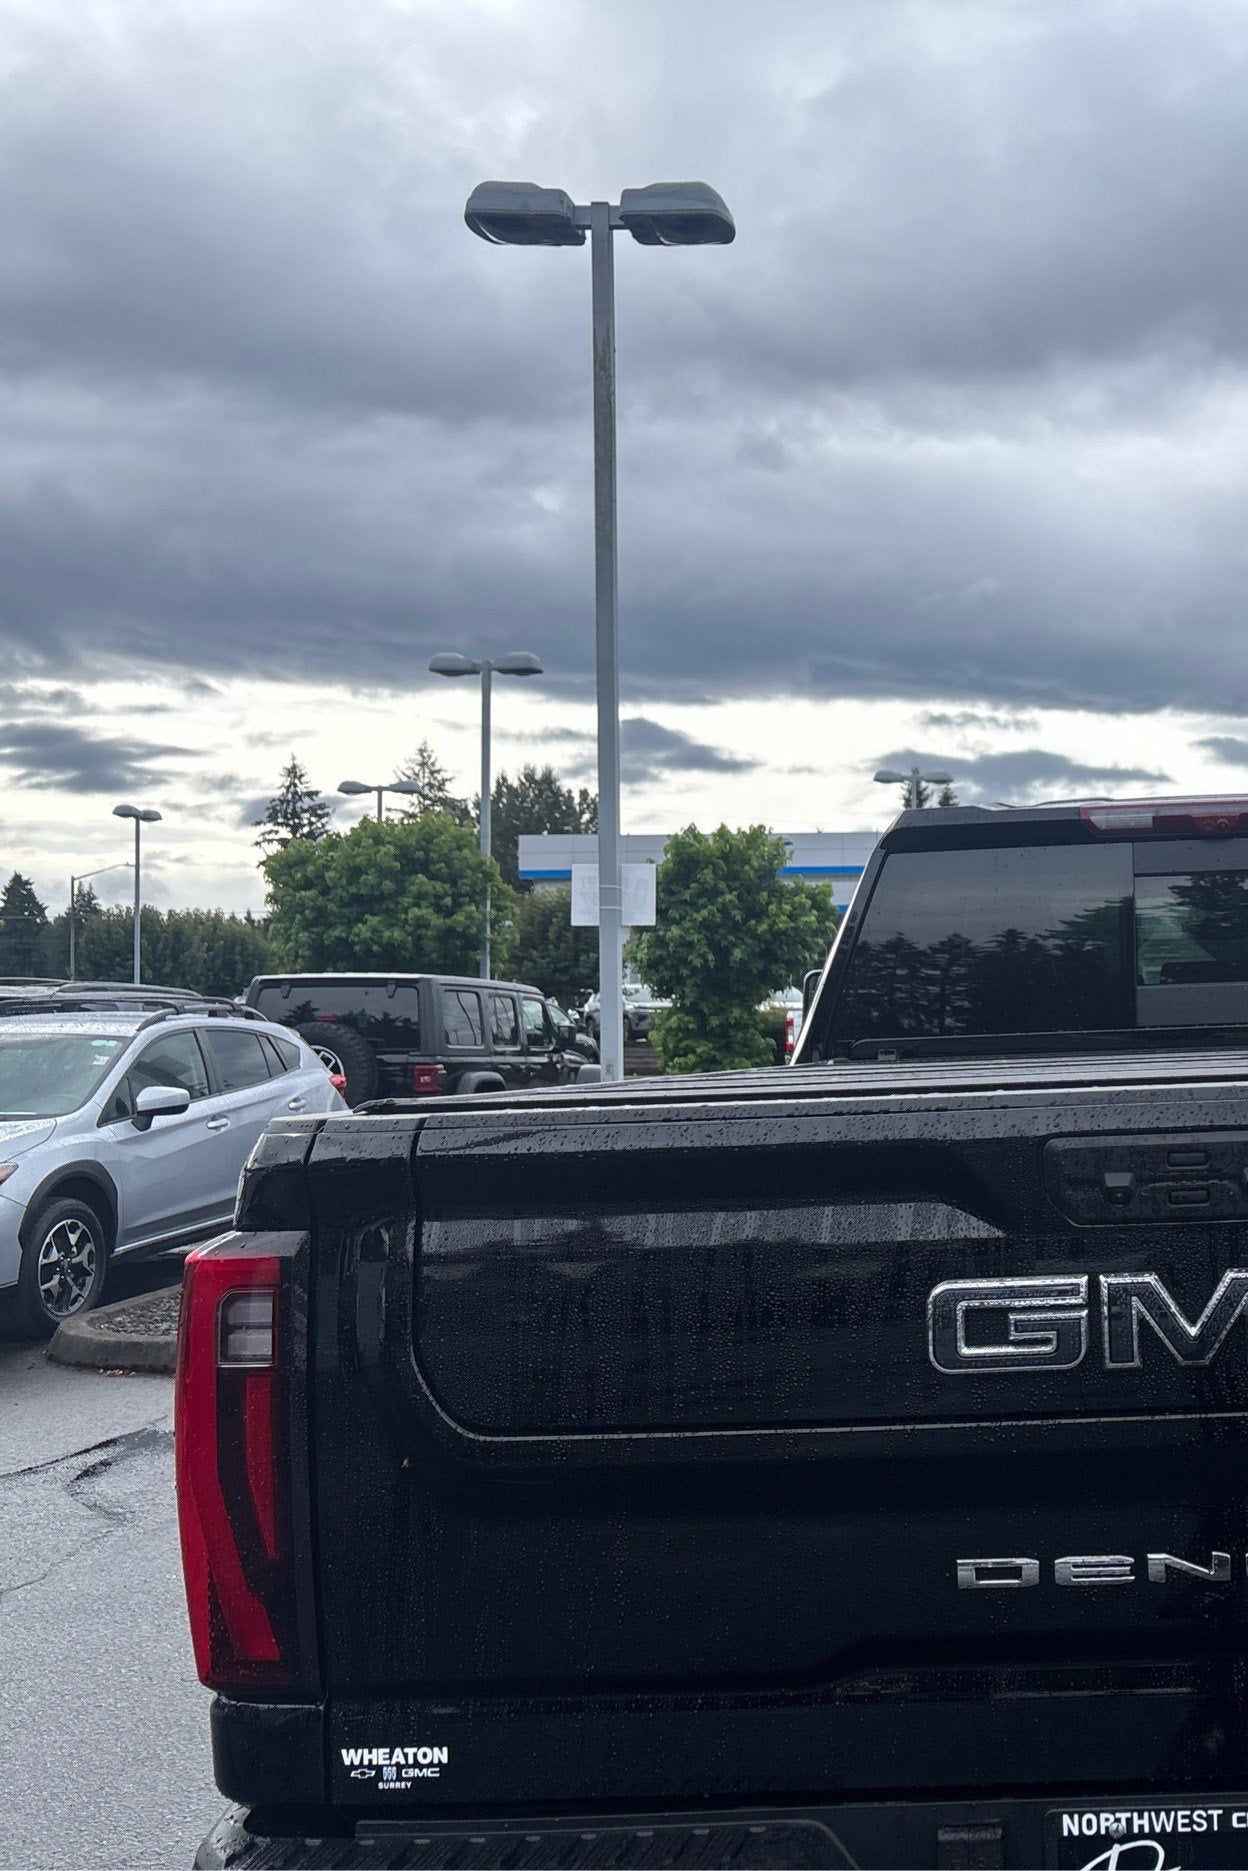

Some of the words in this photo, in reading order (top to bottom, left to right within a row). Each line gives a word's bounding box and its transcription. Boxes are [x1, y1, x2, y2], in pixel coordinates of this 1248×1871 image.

[341, 1746, 448, 1766] WHEATON
[402, 1767, 440, 1778] GMC
[378, 1781, 412, 1790] SURREY
[1062, 1809, 1223, 1836] NORTHWEST
